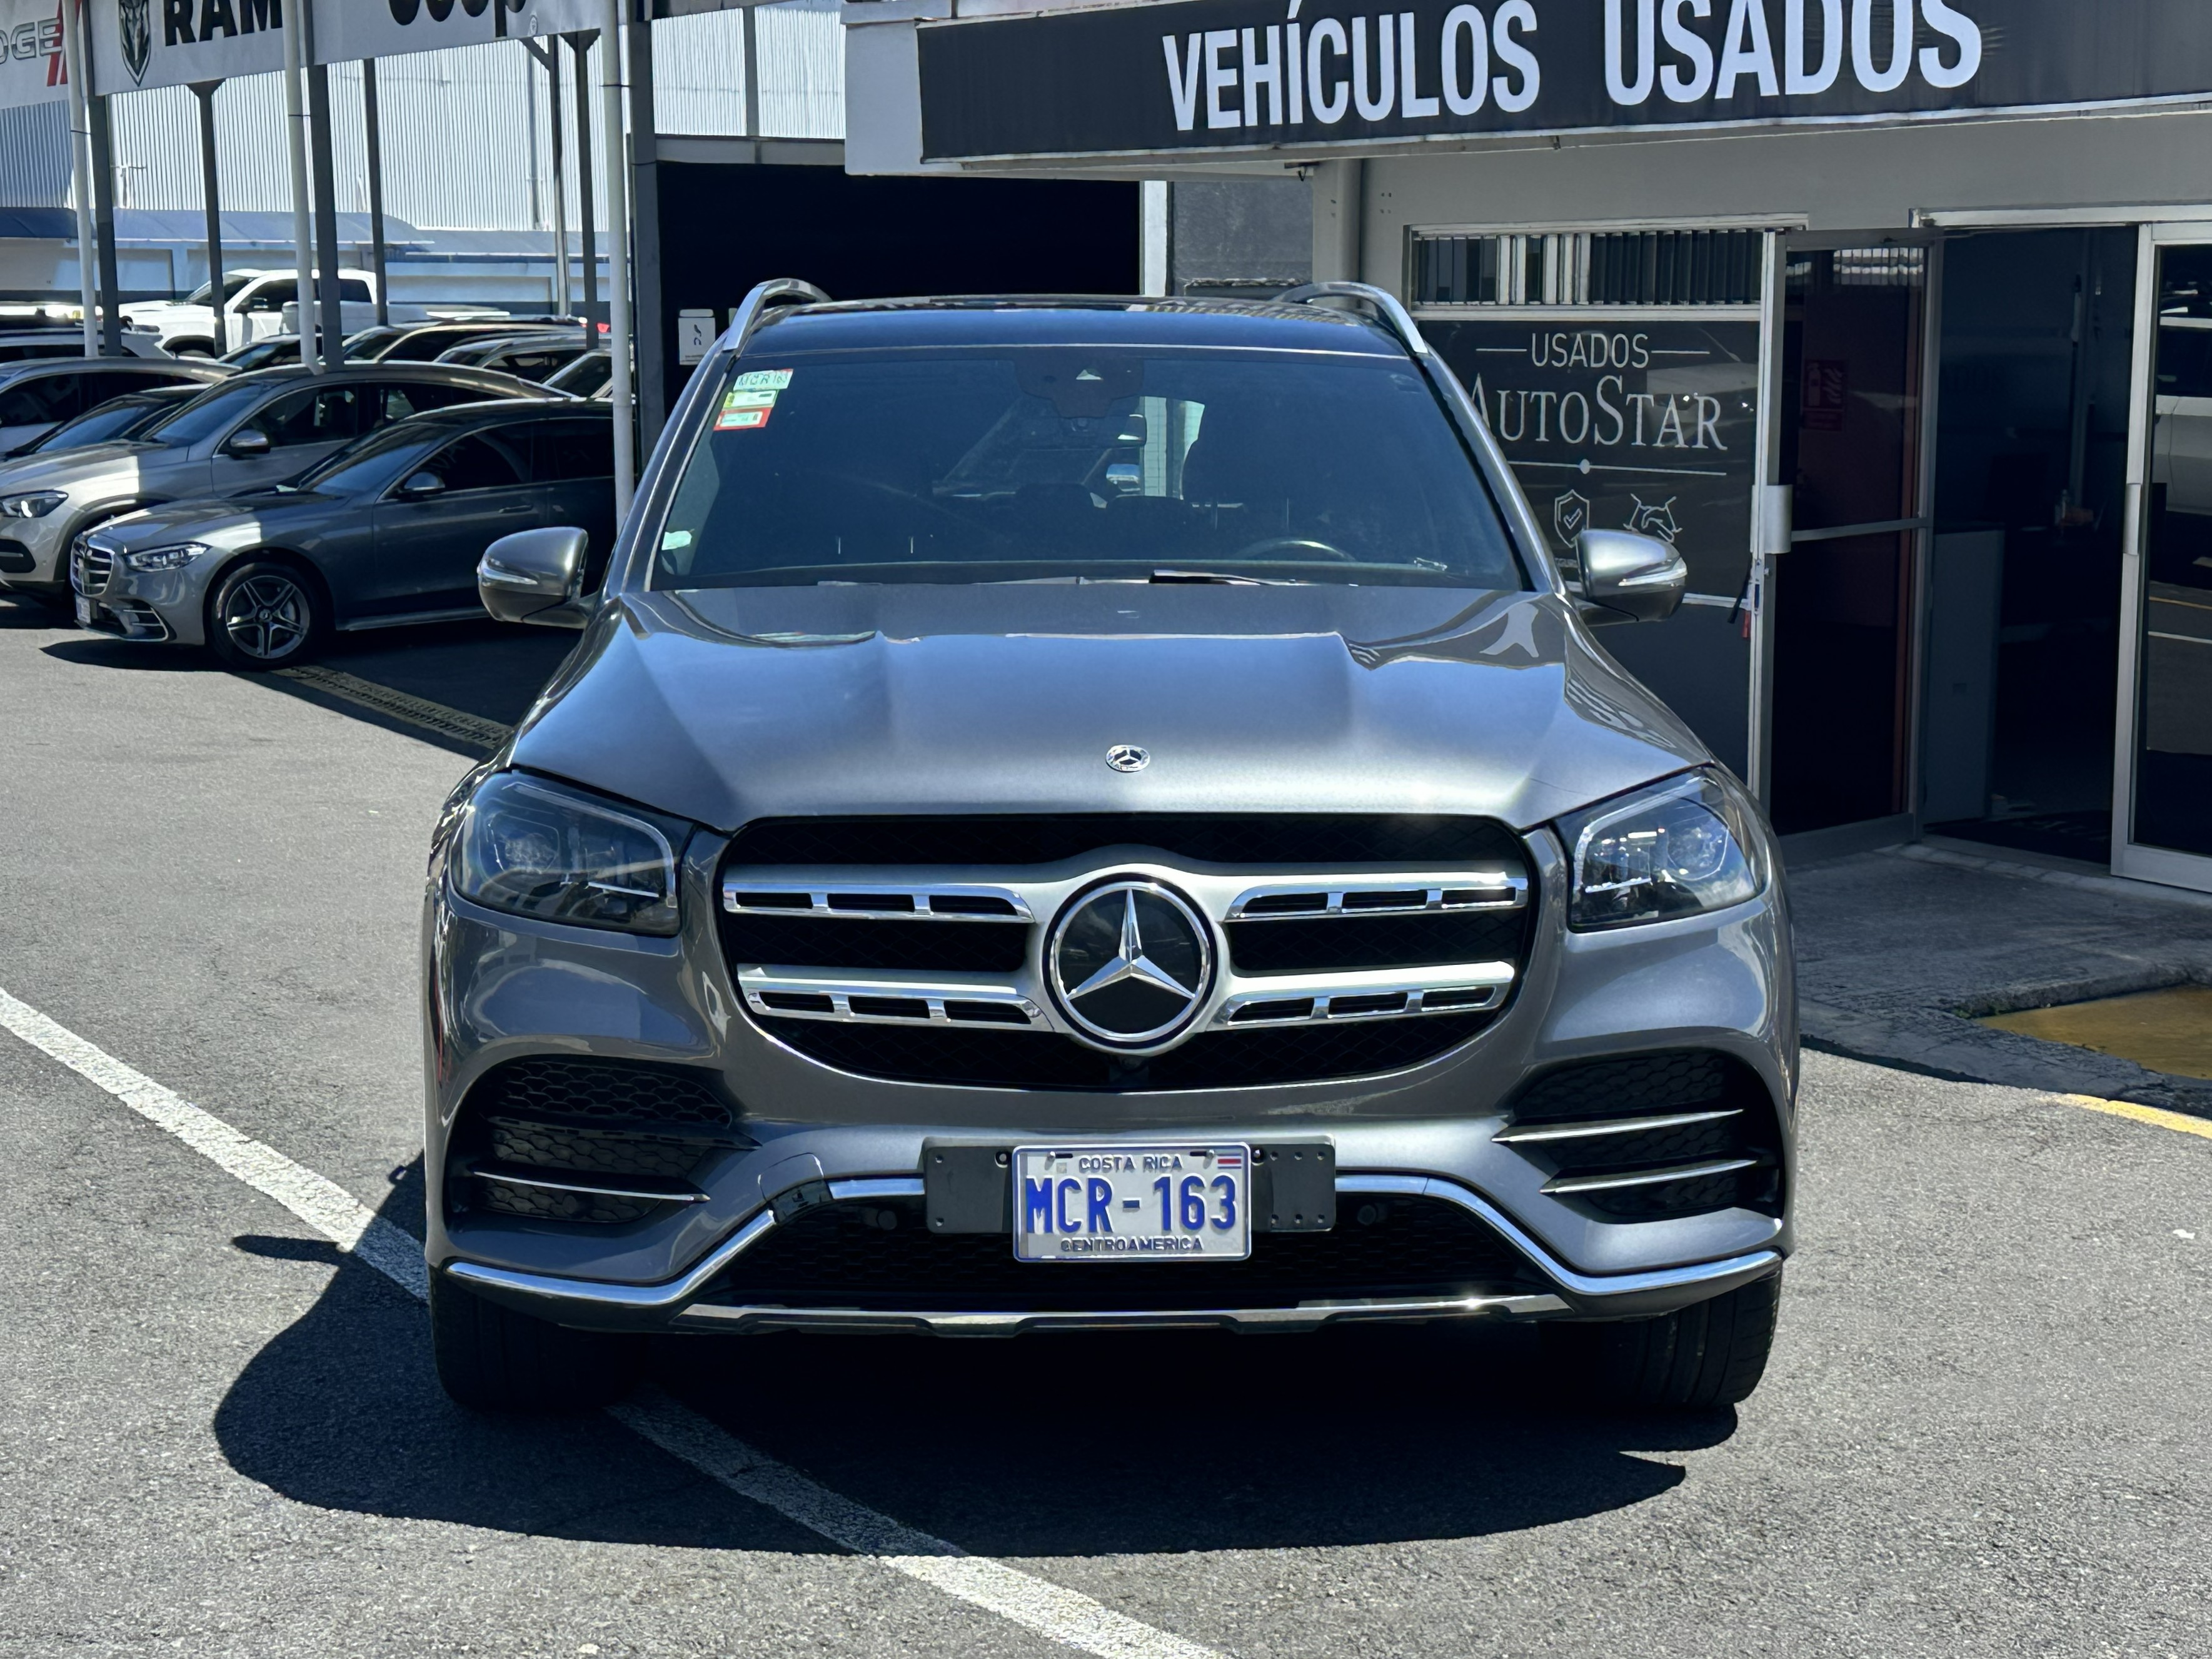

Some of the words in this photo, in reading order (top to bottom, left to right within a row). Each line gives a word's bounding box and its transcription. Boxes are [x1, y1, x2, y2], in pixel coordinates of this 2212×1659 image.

[1162, 0, 1541, 131] VEHÍCULOS
[1604, 0, 1982, 106] USADOS
[1531, 333, 1649, 368] USADOS
[1079, 1154, 1137, 1172] COSTA
[1142, 1153, 1183, 1171] RICA
[1060, 1235, 1205, 1251] CENTROAMERICA
